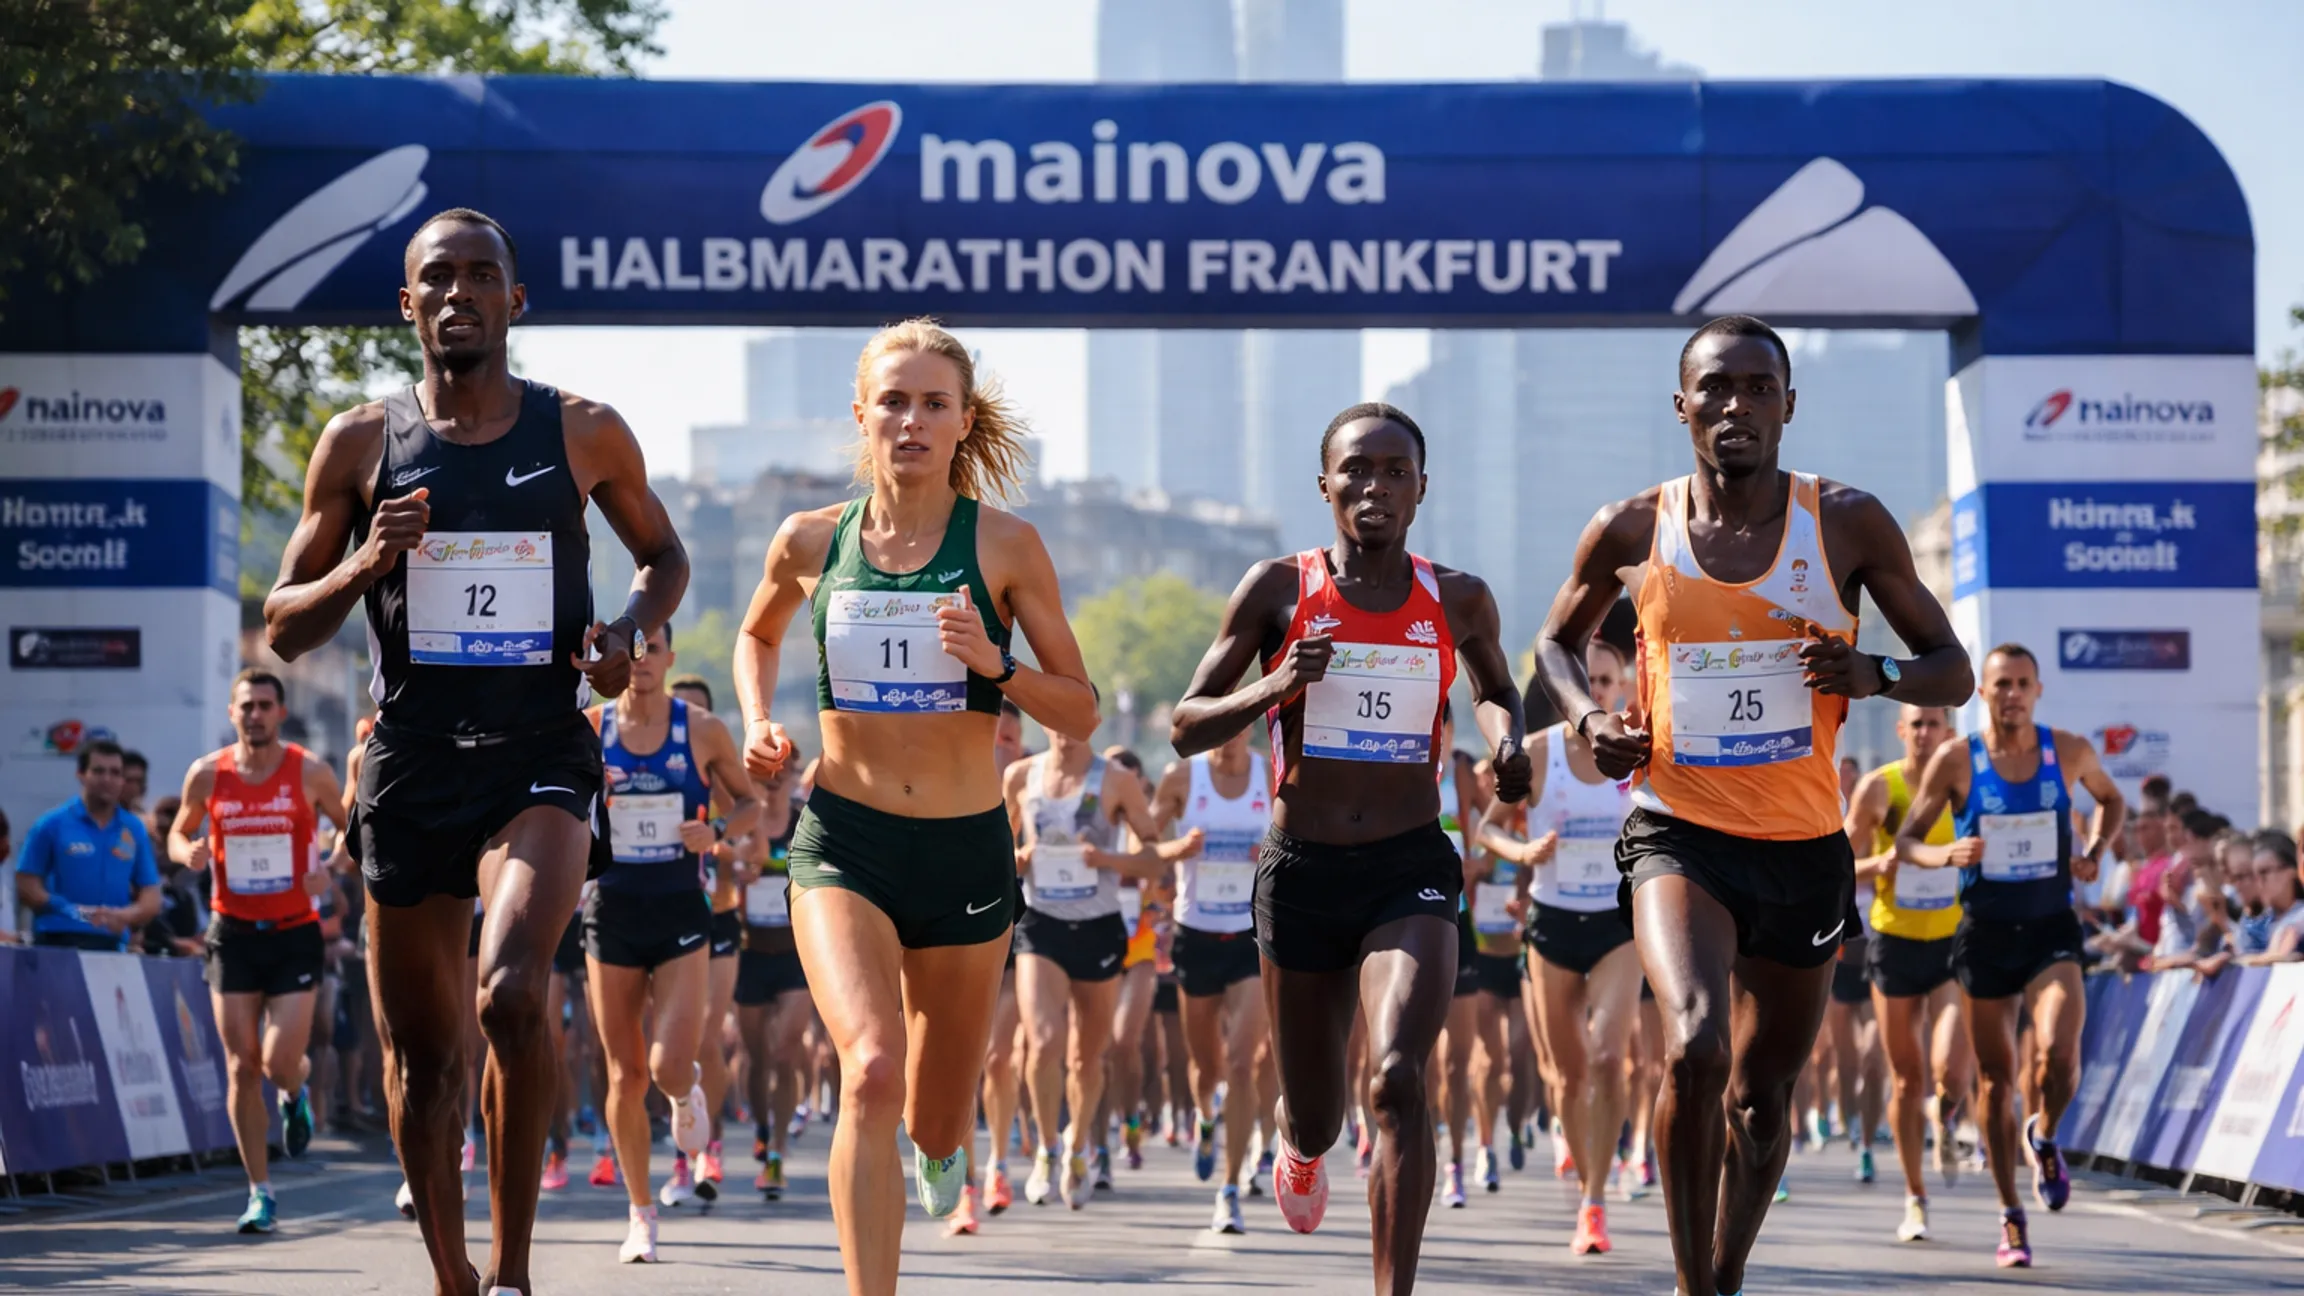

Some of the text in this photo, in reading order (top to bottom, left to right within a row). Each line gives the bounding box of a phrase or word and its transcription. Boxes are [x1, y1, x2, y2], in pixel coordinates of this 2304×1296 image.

[919, 119, 1386, 204] mainova
[561, 237, 1622, 293] HALBMARATHON FRANKFURT
[464, 584, 497, 617] 12
[880, 637, 909, 669] 11
[1728, 689, 1763, 722] 25
